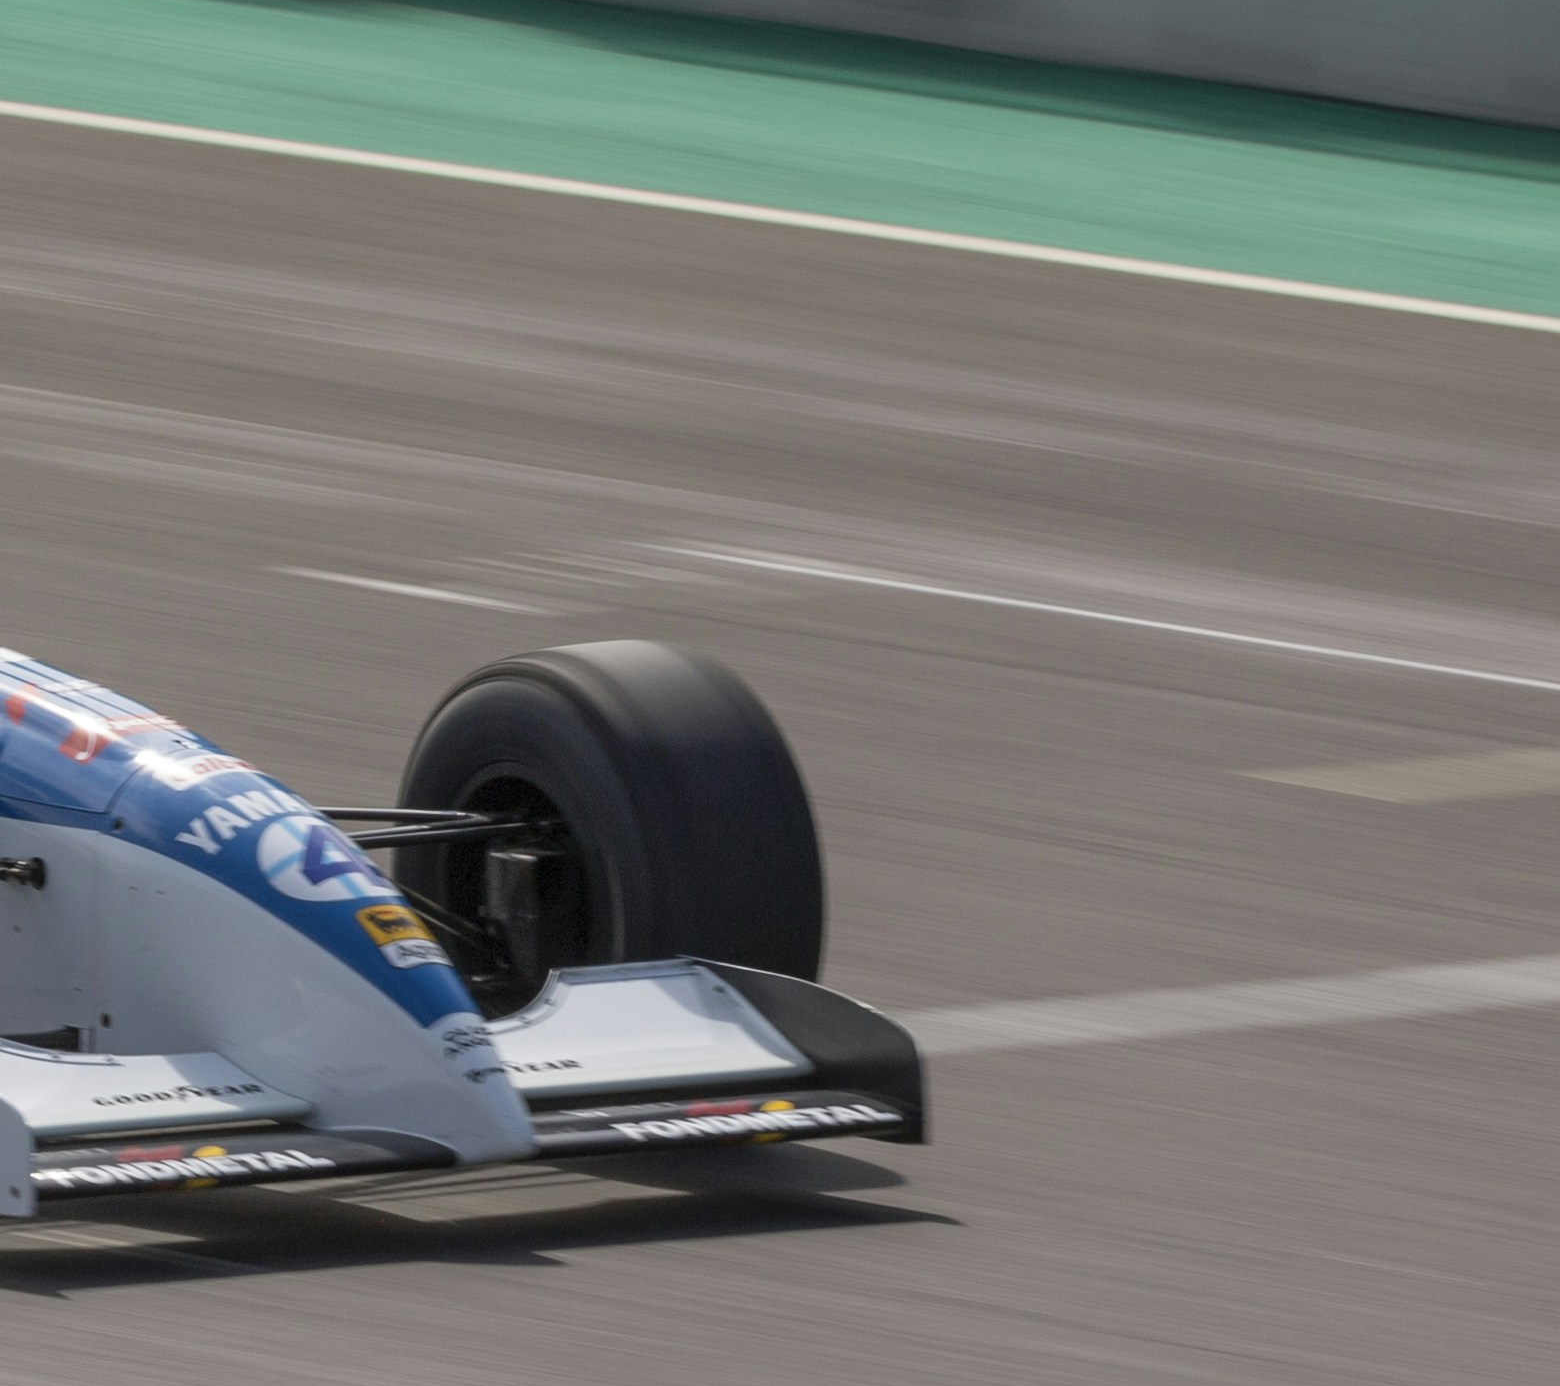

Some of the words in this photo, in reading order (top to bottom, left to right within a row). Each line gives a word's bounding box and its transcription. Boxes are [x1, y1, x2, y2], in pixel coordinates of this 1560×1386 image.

[175, 789, 318, 855] YAMA
[610, 1103, 904, 1142] FONDMETAL
[31, 1149, 337, 1188] FONDMETAL
